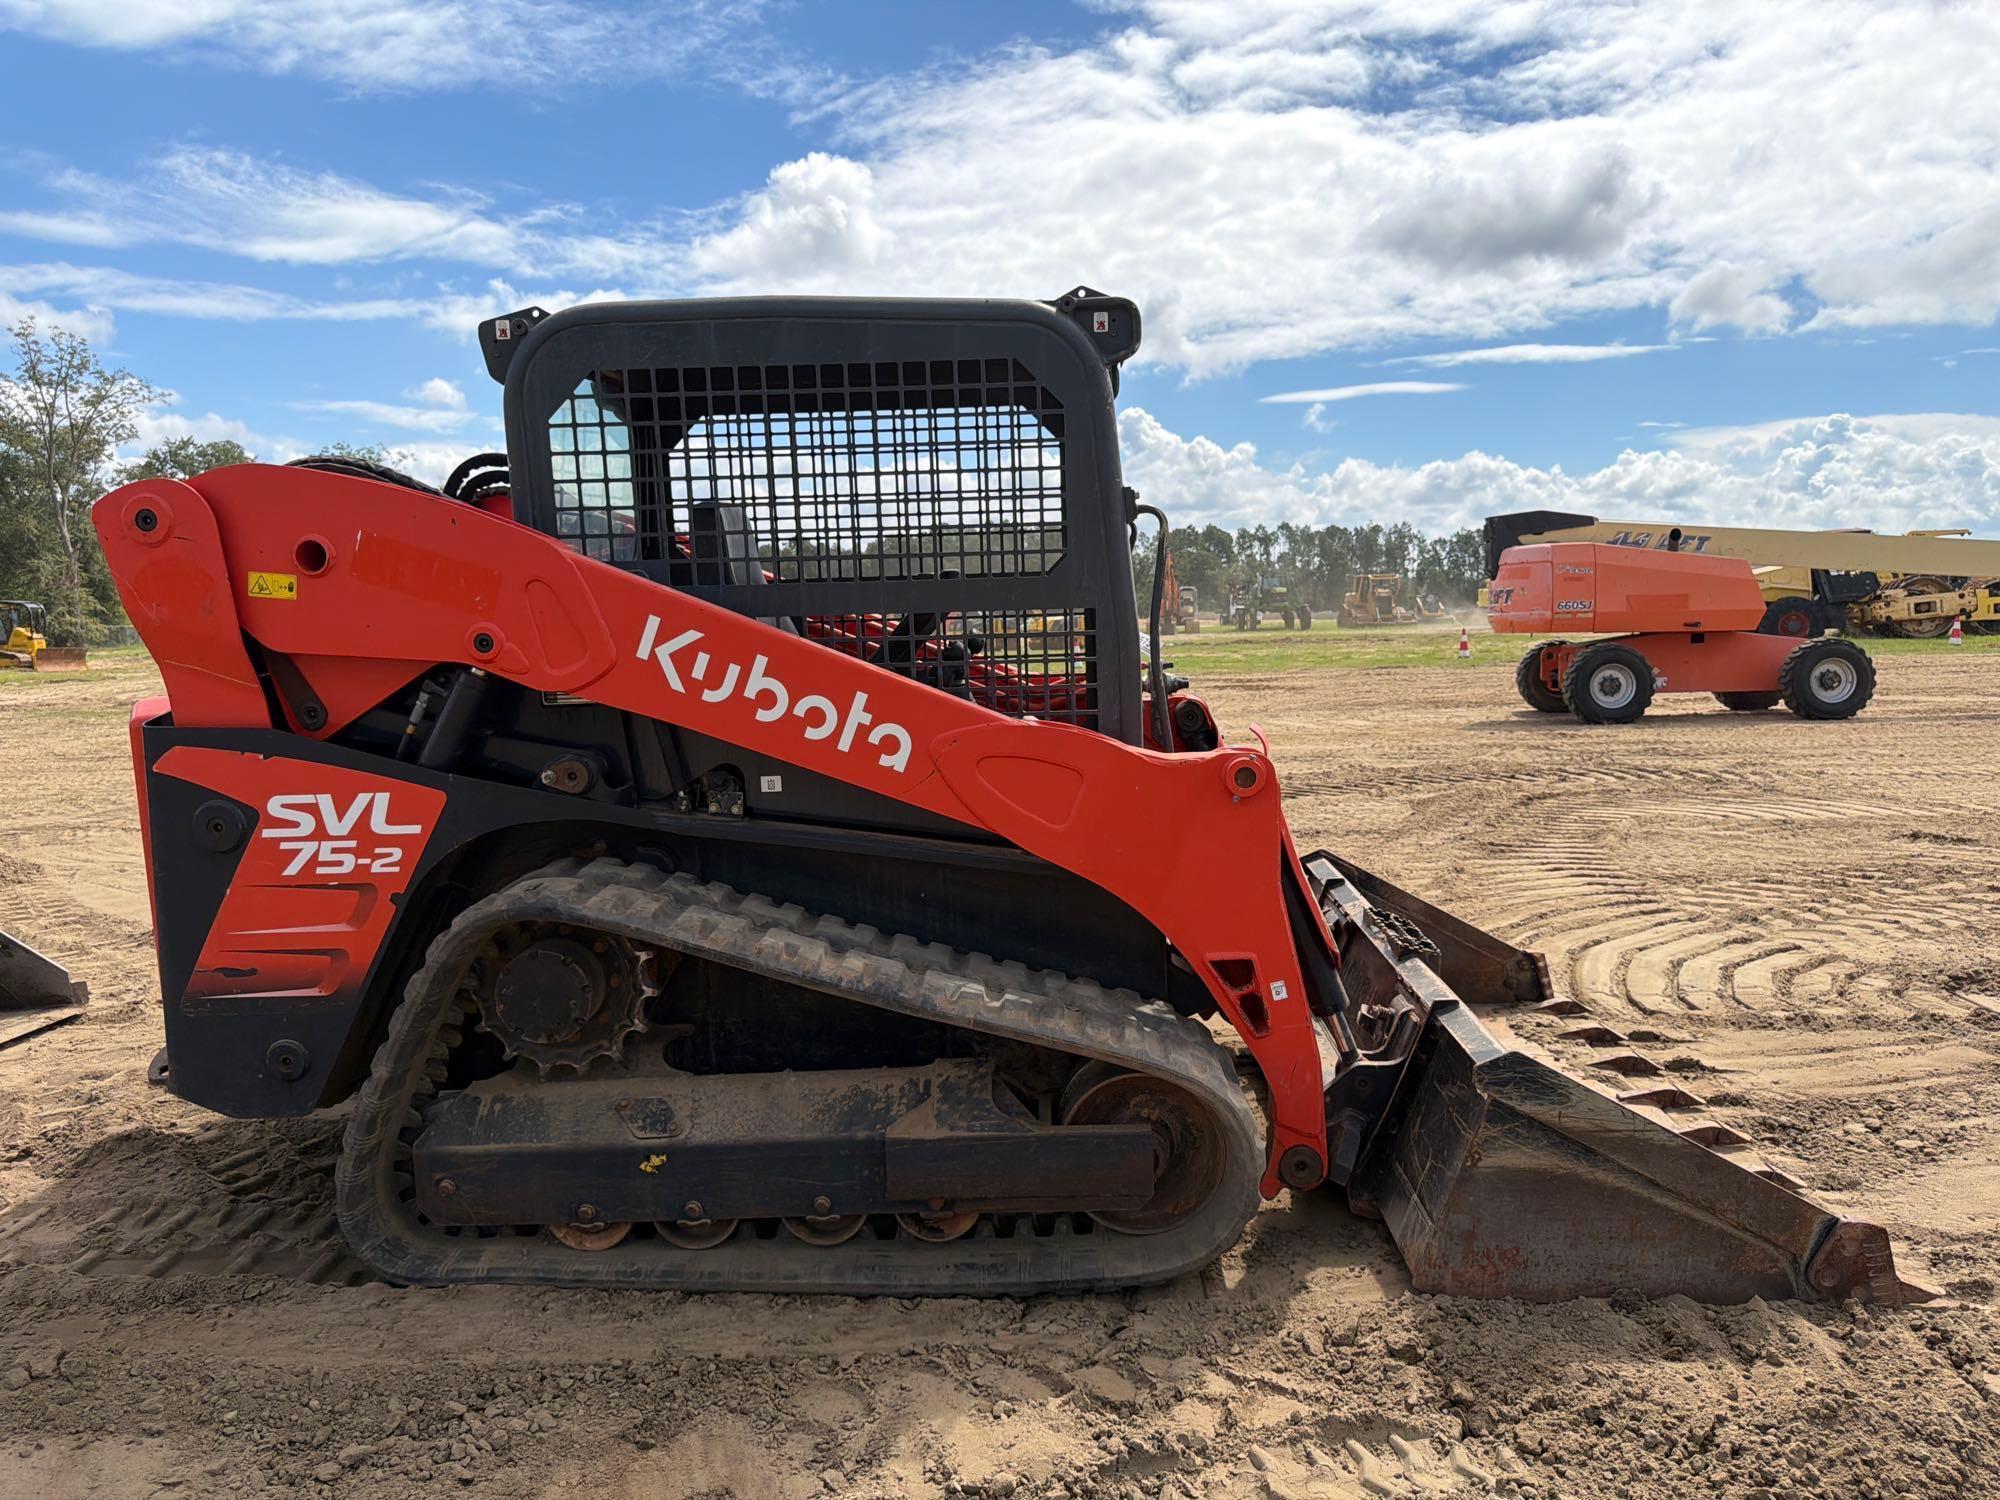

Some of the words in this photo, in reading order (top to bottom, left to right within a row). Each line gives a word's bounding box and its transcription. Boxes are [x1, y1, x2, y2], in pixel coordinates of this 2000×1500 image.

[1655, 532, 1713, 552] LFT
[1556, 600, 1593, 610] 660SJ
[636, 614, 912, 773] Kubota
[261, 792, 422, 838] SVL
[279, 840, 403, 876] 75-2
